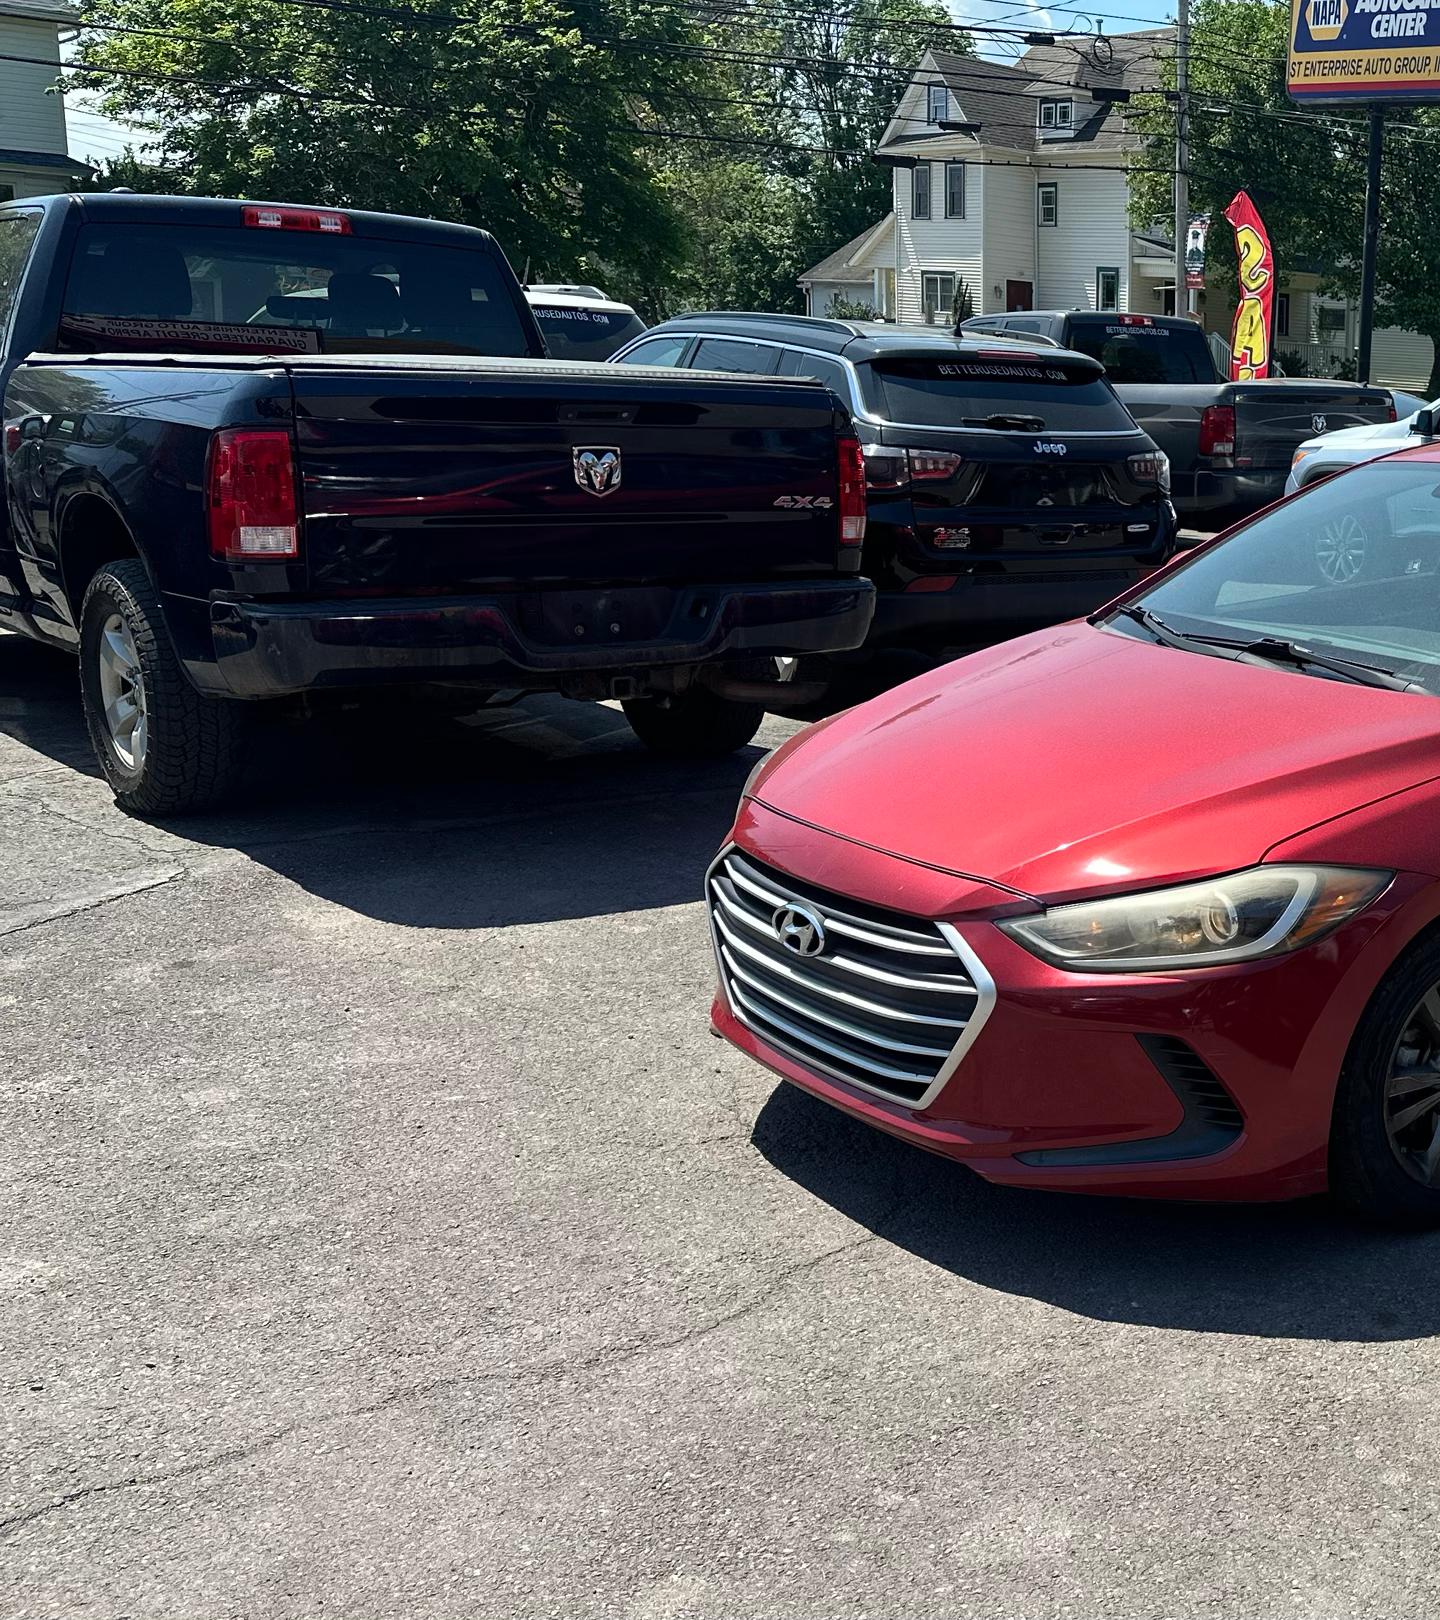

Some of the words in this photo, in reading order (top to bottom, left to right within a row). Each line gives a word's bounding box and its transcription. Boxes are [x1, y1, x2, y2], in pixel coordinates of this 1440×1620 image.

[1311, 0, 1341, 26] NAPA
[1370, 12, 1427, 38] CENTER
[1290, 61, 1302, 77] ST
[1303, 59, 1363, 77] ENTERPRISE
[1364, 57, 1391, 75] AUTO
[1394, 55, 1431, 77] GROUP,
[1033, 440, 1067, 456] Jeep
[773, 495, 834, 509] 4X4
